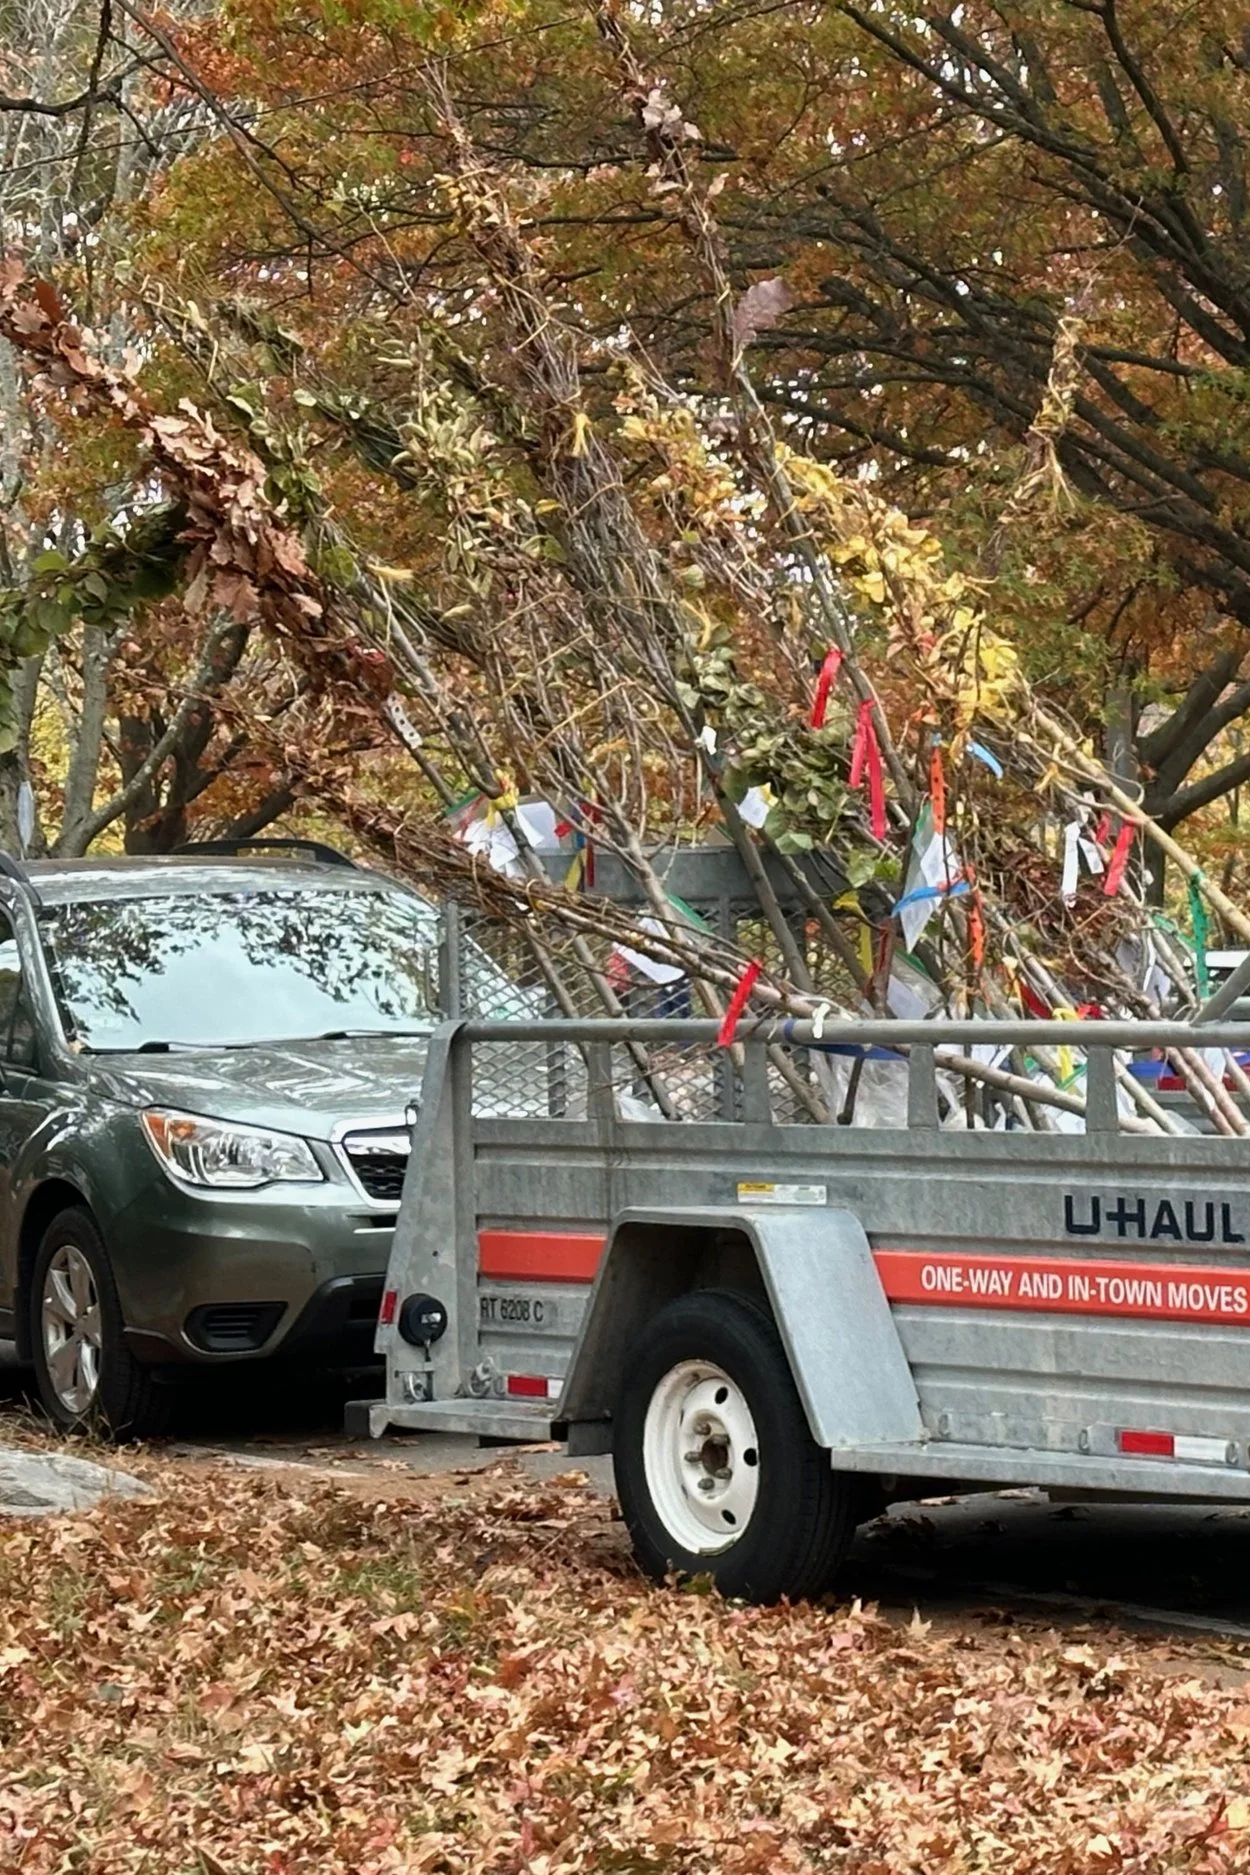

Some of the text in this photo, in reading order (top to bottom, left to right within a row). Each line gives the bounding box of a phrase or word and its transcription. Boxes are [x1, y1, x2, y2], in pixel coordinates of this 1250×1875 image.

[1064, 1195, 1245, 1243] U-HAUL
[480, 1297, 498, 1319] RT
[533, 1300, 544, 1322] C
[921, 1265, 1249, 1314] ONE-WAY AND IN-TOWN MOVES
